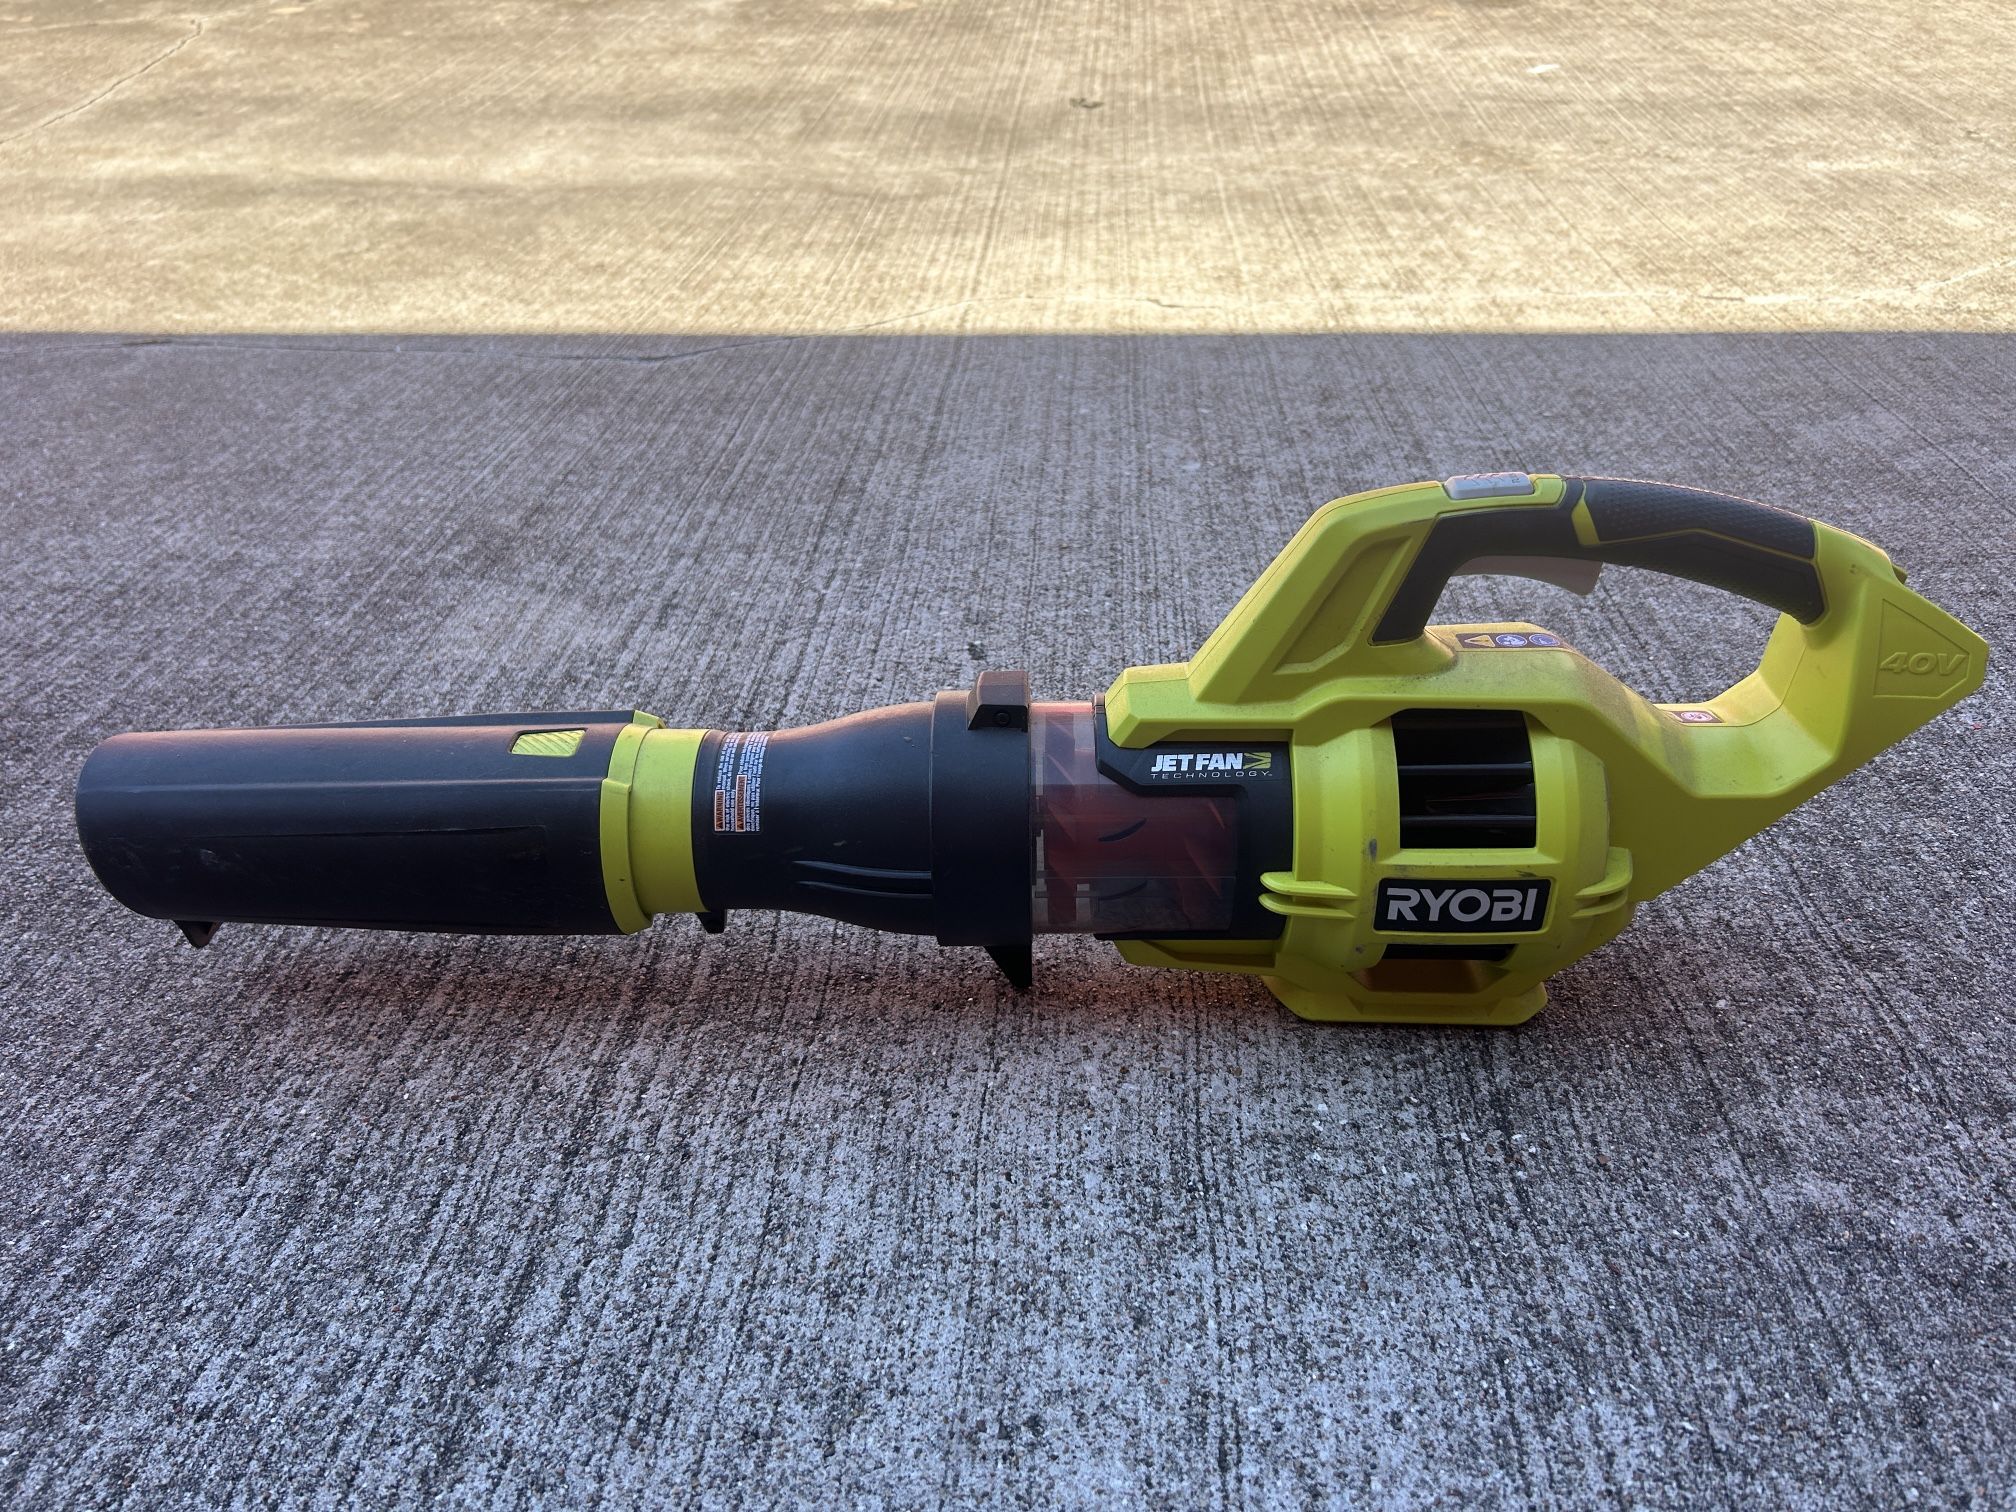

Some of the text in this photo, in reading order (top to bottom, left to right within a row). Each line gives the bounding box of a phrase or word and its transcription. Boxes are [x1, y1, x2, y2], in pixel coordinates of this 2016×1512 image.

[1880, 651, 1967, 676] 40V
[1151, 752, 1243, 772] JET FAN
[1151, 770, 1271, 779] TECHNOLOGY
[737, 776, 745, 822] AVERTISSEMENT
[1386, 888, 1538, 922] RYOBI
